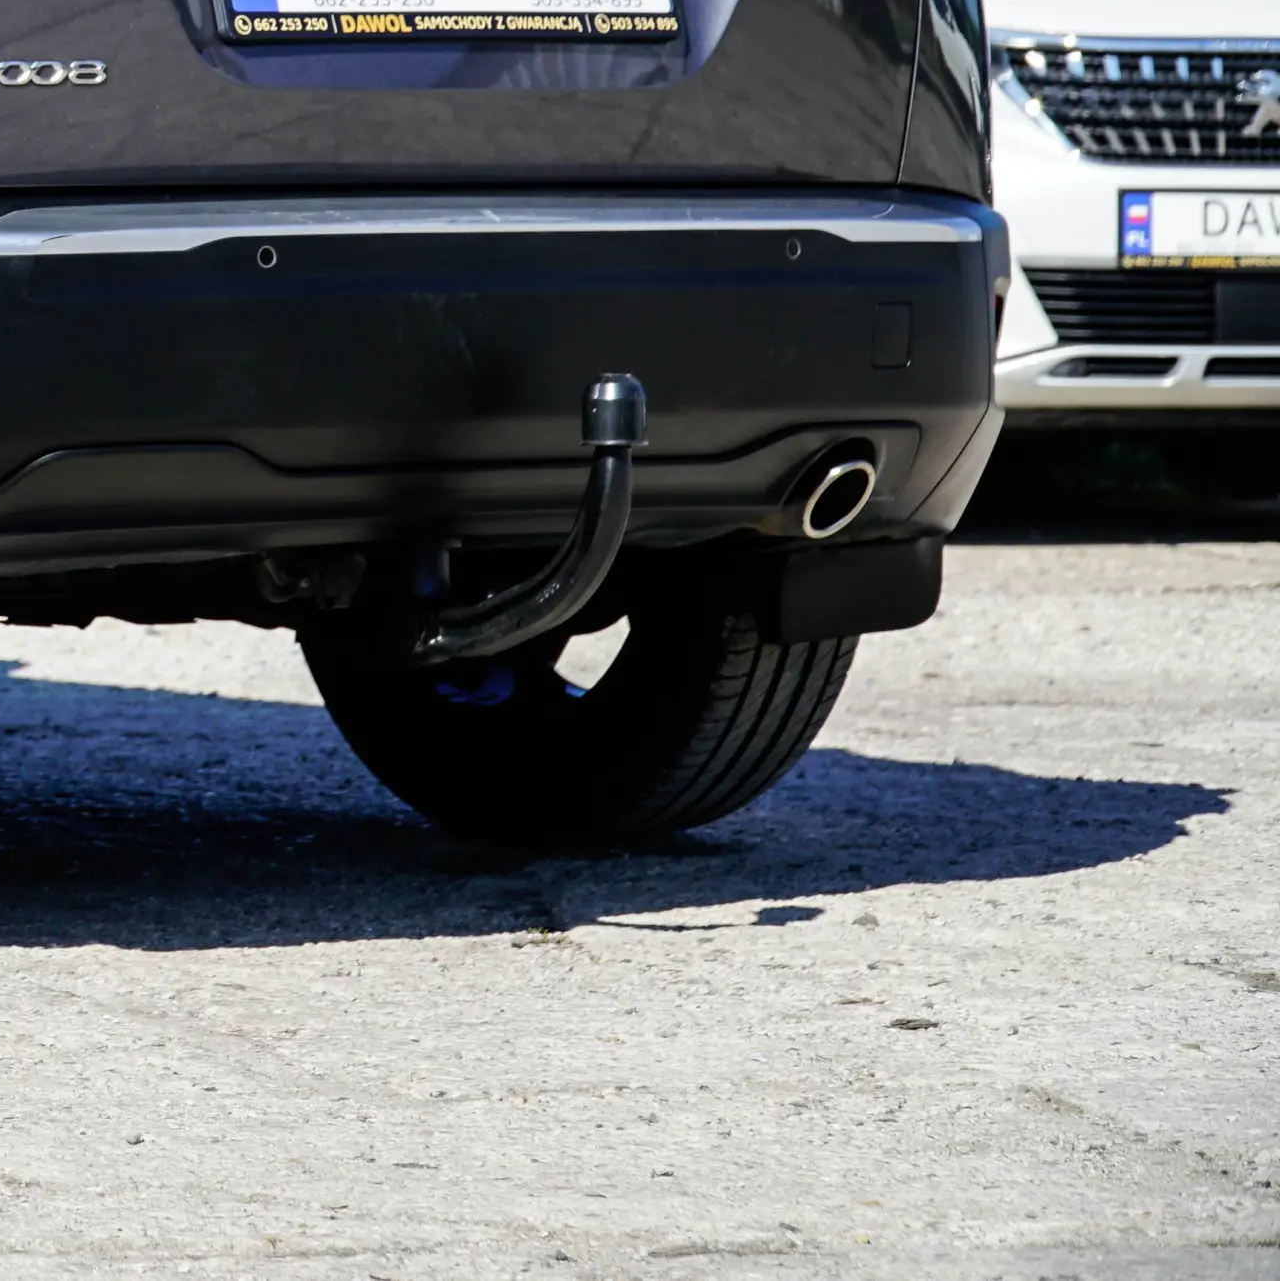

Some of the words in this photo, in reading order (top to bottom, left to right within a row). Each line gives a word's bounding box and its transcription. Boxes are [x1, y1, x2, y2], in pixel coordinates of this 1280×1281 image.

[253, 17, 278, 32] 662
[279, 17, 303, 32] 253
[304, 17, 329, 32] 250
[340, 14, 413, 34] DAWOL
[414, 15, 493, 31] SAMOCHODY
[494, 16, 506, 30] Z
